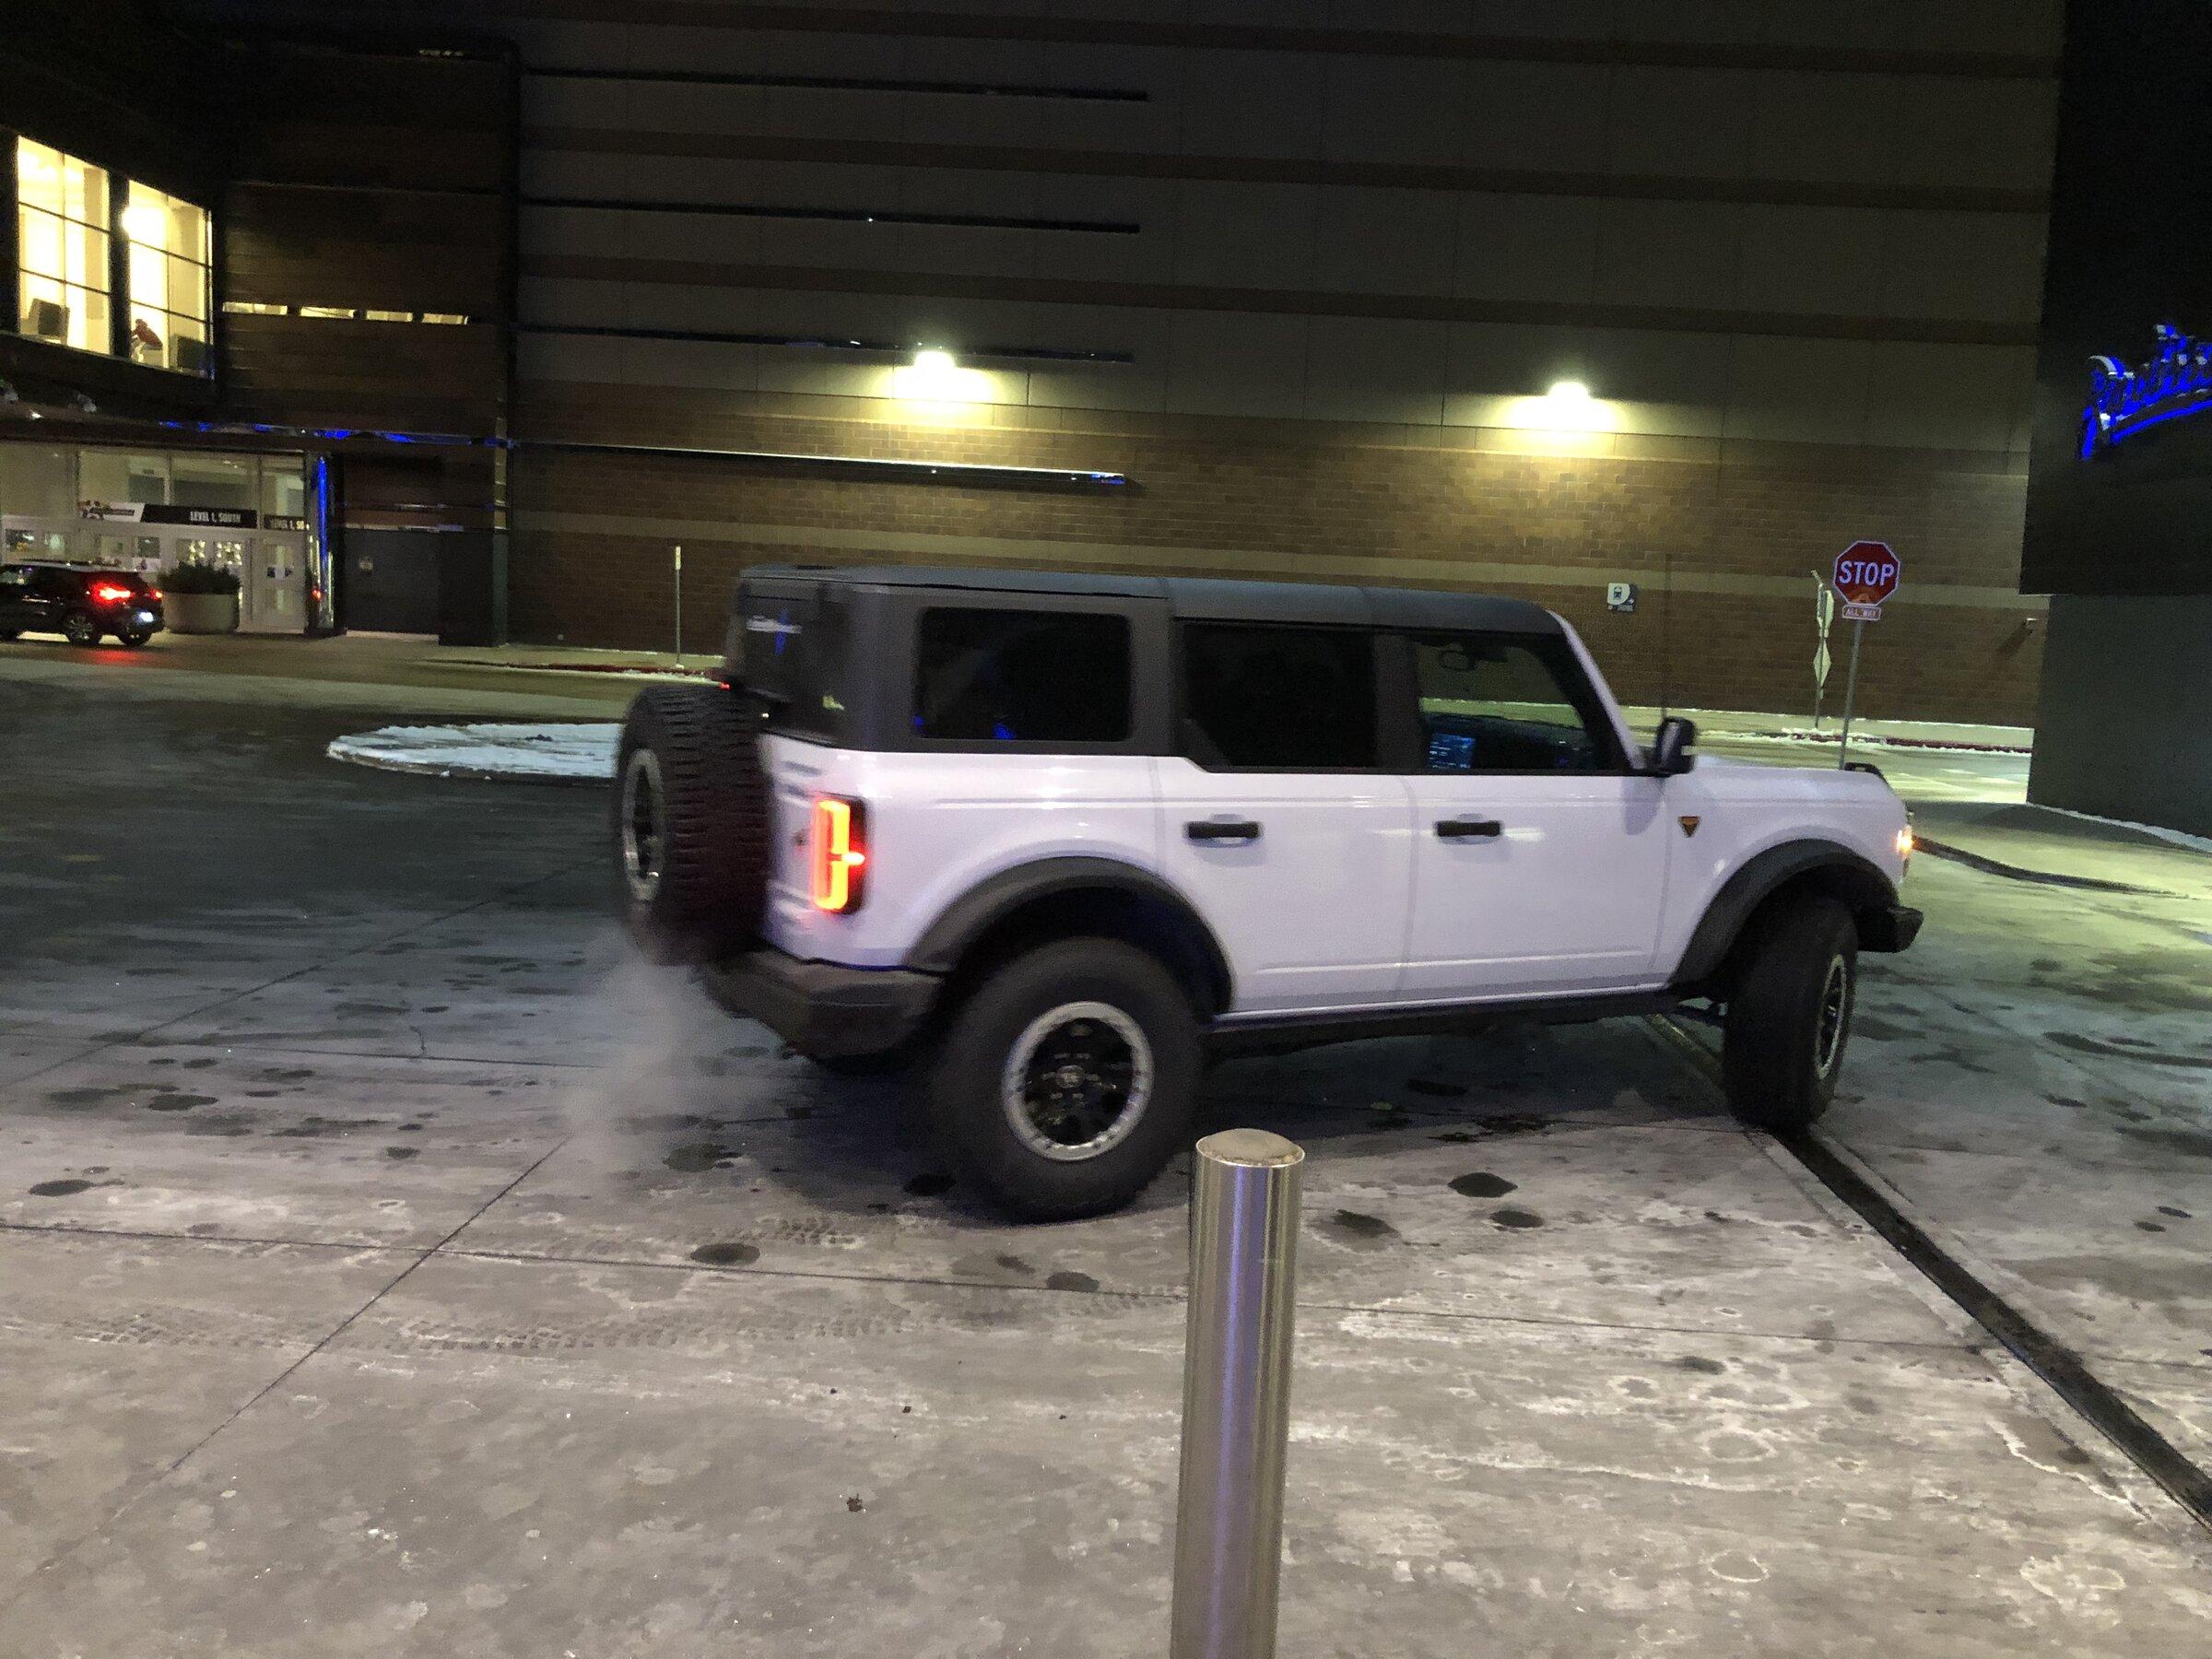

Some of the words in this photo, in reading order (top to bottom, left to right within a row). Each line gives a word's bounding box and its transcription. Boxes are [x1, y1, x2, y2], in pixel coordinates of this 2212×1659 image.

[190, 511, 210, 522] LEVEL
[218, 512, 241, 524] SOUTH
[1839, 560, 1895, 586] STOP
[1845, 608, 1860, 617] ALL
